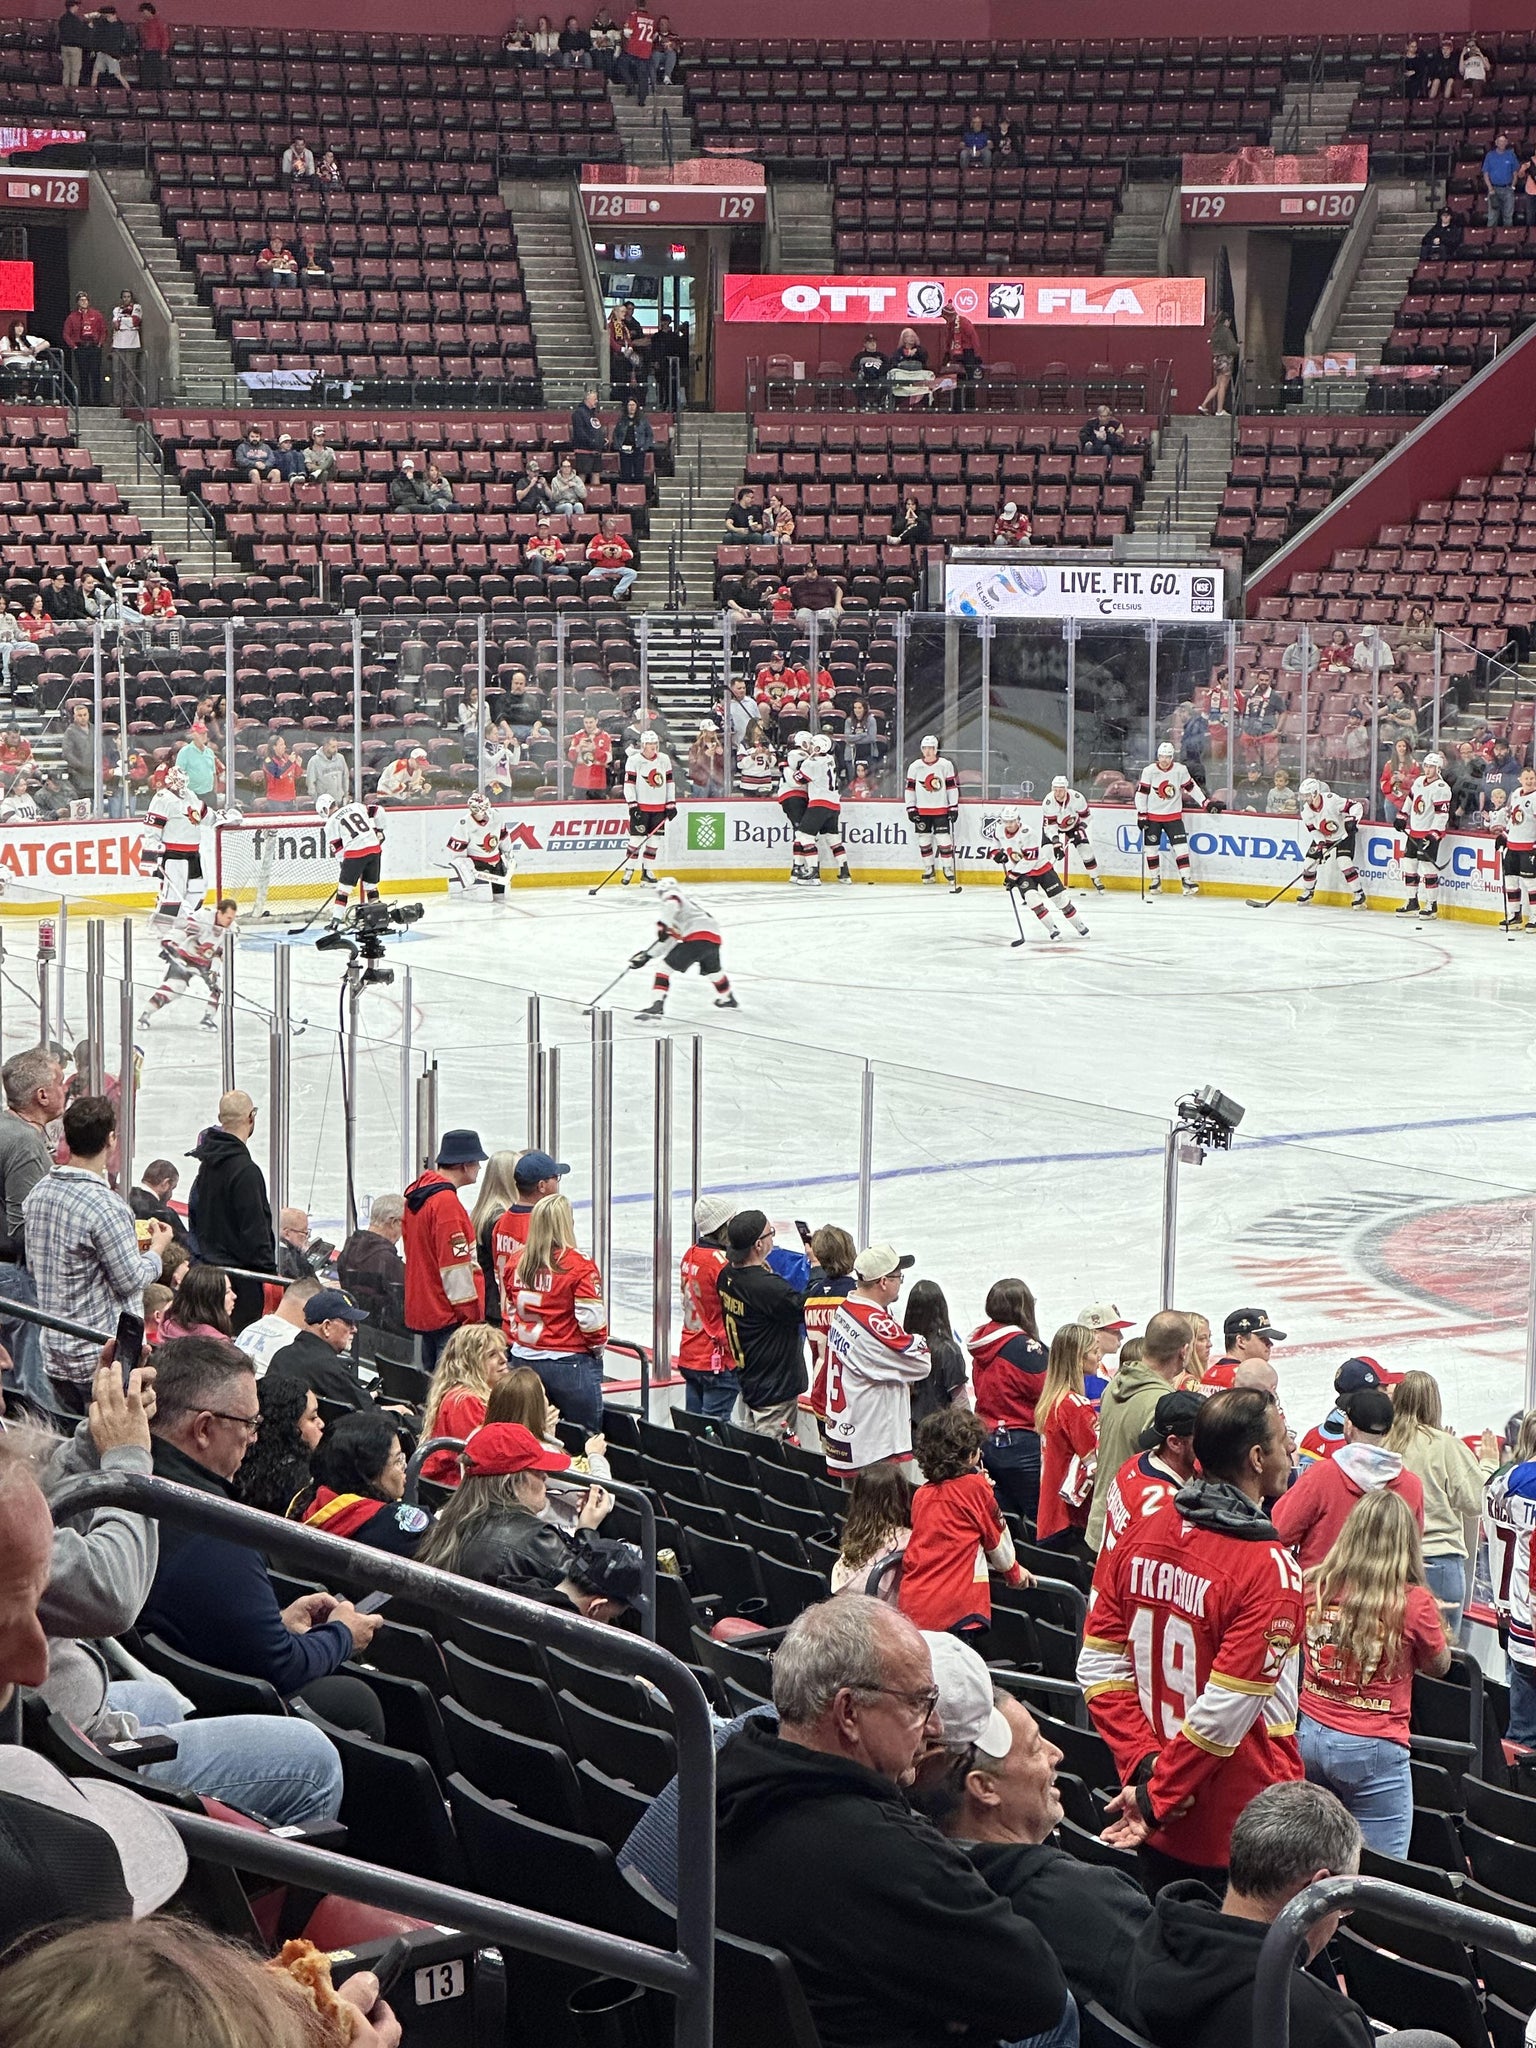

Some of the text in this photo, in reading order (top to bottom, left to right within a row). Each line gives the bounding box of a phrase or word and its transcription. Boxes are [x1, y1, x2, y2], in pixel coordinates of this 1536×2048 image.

[638, 23, 655, 43] 72
[46, 181, 80, 204] 128
[589, 195, 623, 217] 128
[719, 197, 755, 218] 129
[1190, 196, 1226, 218] 129
[1319, 195, 1355, 217] 130
[781, 285, 897, 313] OTT
[958, 295, 974, 305] VS
[1038, 287, 1145, 315] FLA
[1060, 571, 1181, 596] LIVE. FIT. GO.
[975, 581, 995, 611] CELSIUS
[1112, 603, 1142, 611] CELSIUS
[1486, 773, 1503, 784] USA
[143, 812, 156, 824] 35
[340, 812, 370, 839] 18
[550, 819, 629, 837] ACTION
[450, 839, 462, 851] 47
[1026, 850, 1036, 860] 71
[1438, 875, 1470, 890] Cooper
[516, 1290, 544, 1345] 5
[1131, 1556, 1212, 1618] TKACHUK
[1127, 1606, 1197, 1741] 19
[425, 1964, 454, 2000] 13
